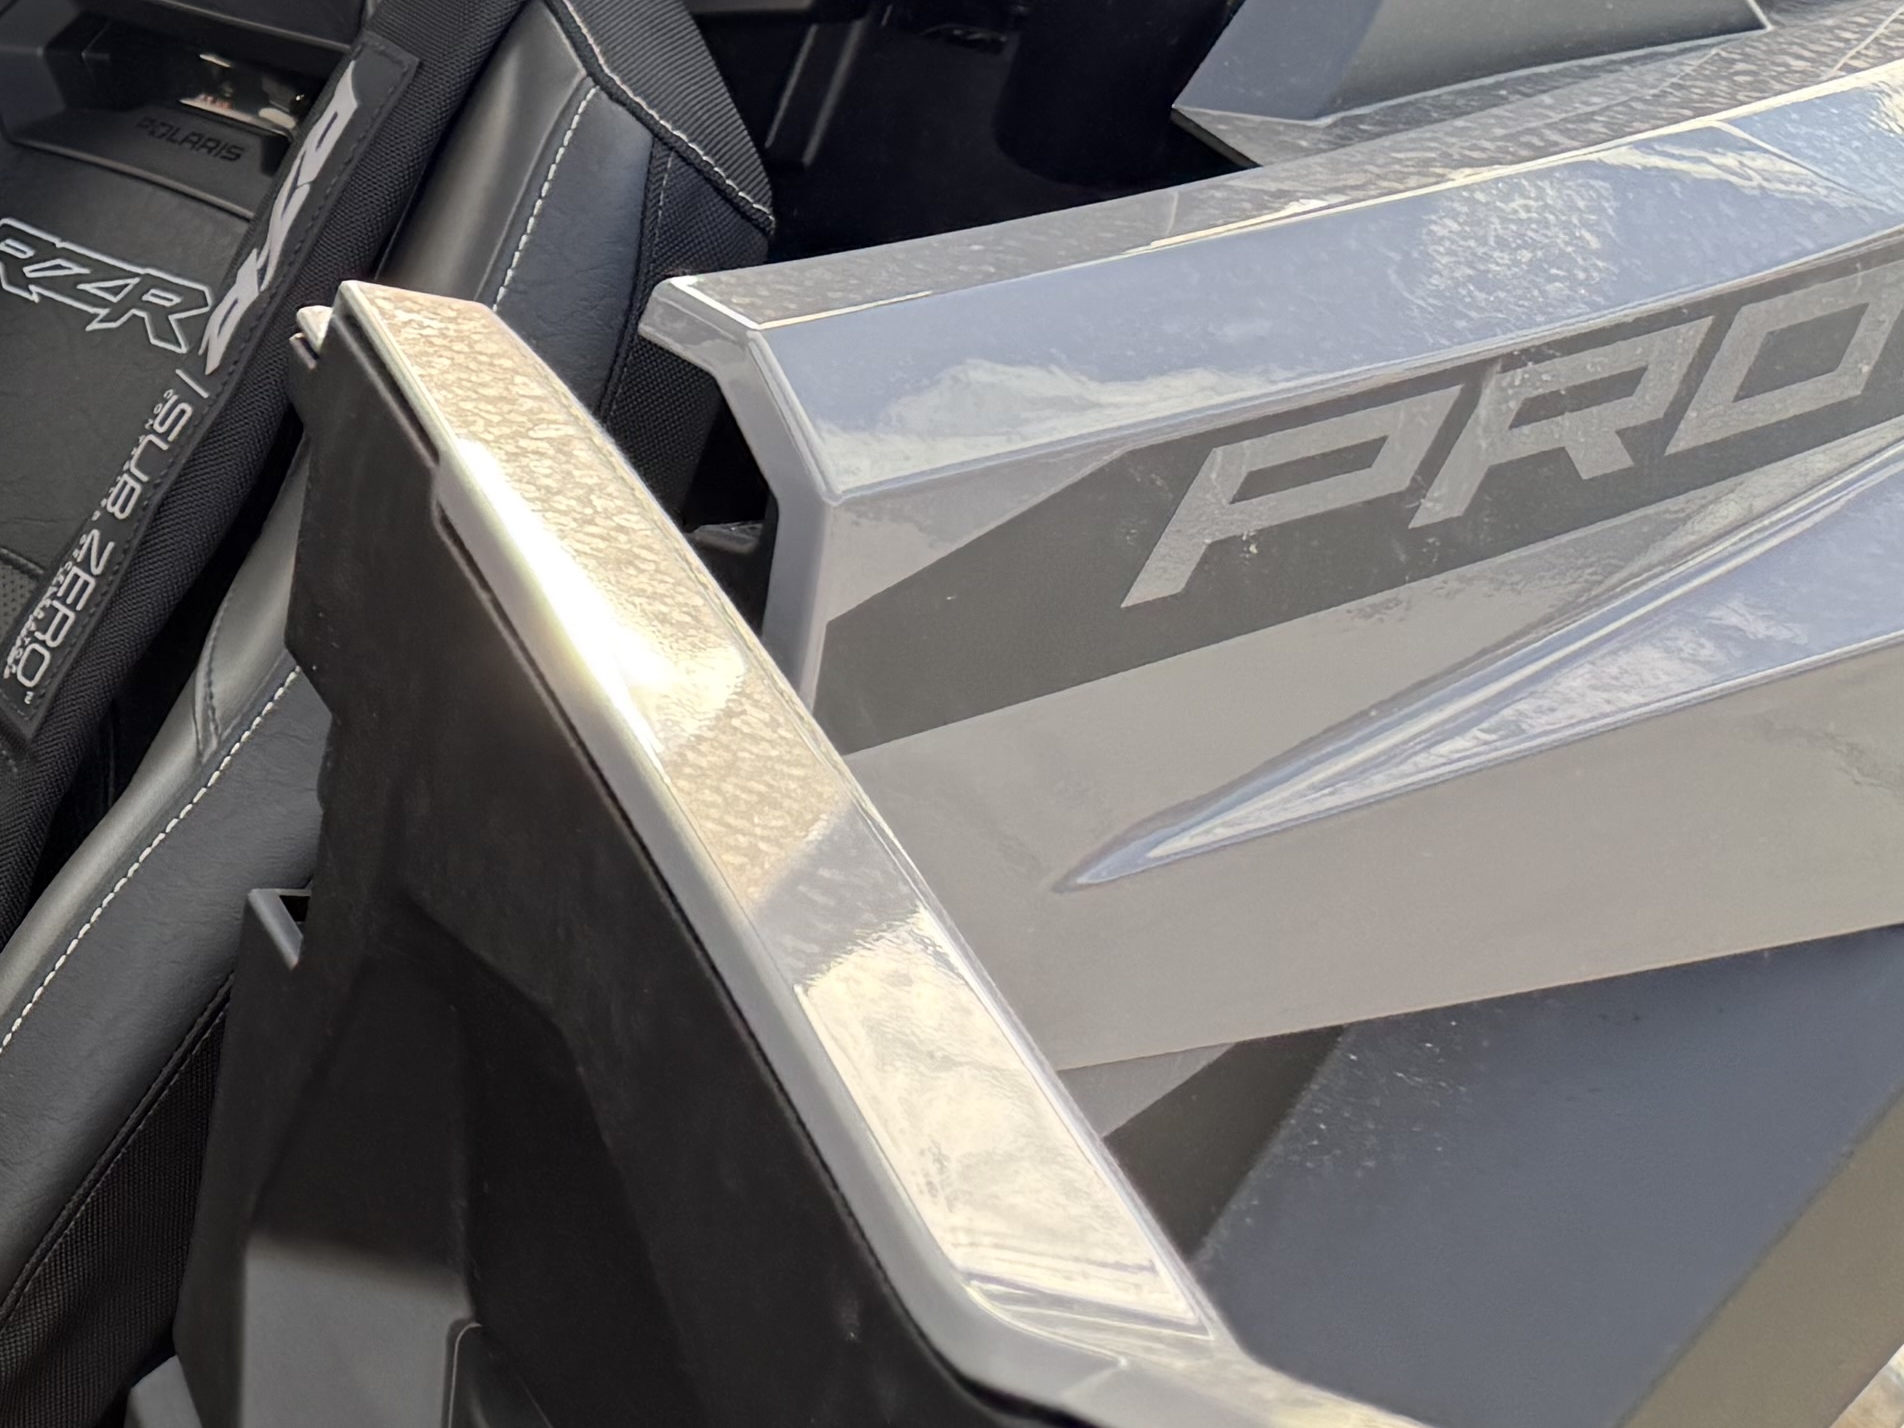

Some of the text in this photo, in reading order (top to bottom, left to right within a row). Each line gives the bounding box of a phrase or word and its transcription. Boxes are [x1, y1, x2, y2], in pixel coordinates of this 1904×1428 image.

[135, 115, 245, 163] POLARIS
[197, 60, 359, 376] RZR
[106, 393, 193, 520] SUB
[1120, 258, 1904, 610] PRO
